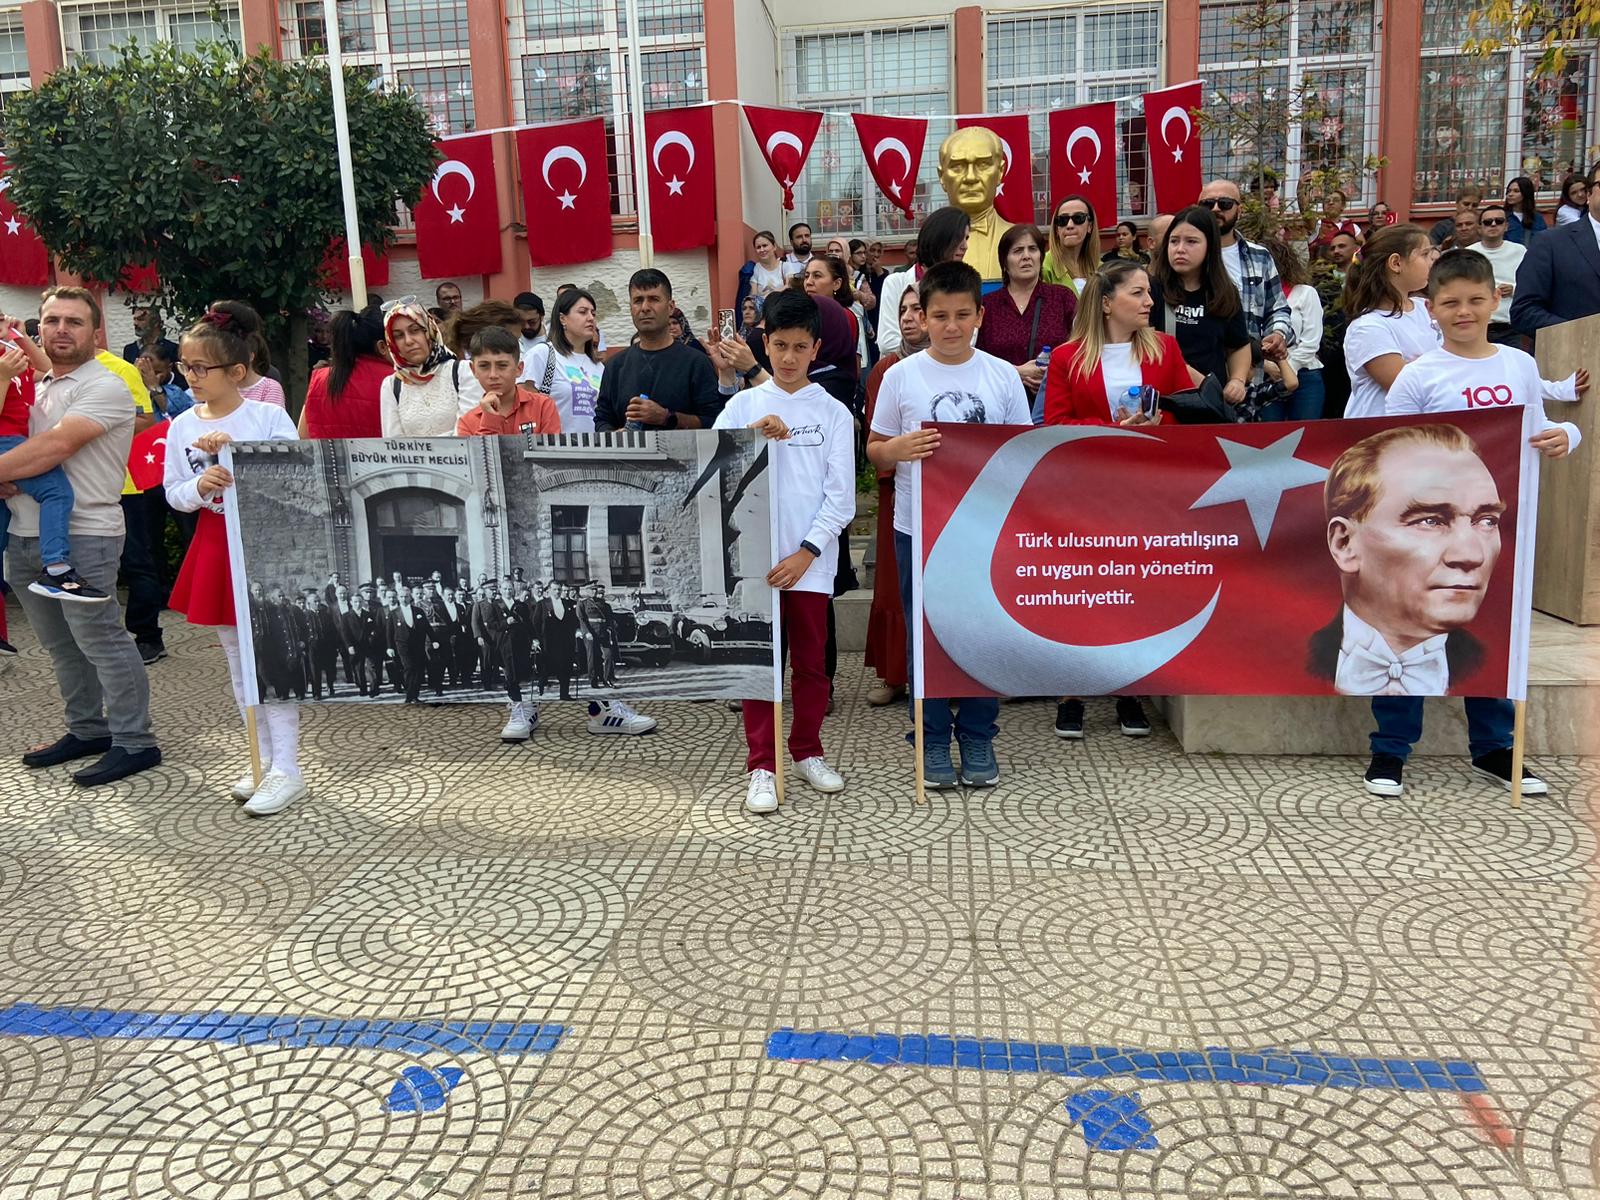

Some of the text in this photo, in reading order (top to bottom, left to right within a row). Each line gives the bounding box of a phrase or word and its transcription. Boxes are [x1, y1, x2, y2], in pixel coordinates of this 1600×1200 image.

[384, 439, 433, 452] TÜRKİYE
[351, 451, 468, 466] BÜYÜK MİLLET MECLİSİ
[1015, 530, 1239, 550] Türk ulusunun yaratılışına
[1015, 560, 1214, 580] en uygun olan yönetim
[1015, 588, 1136, 608] cumhuriyettir.
